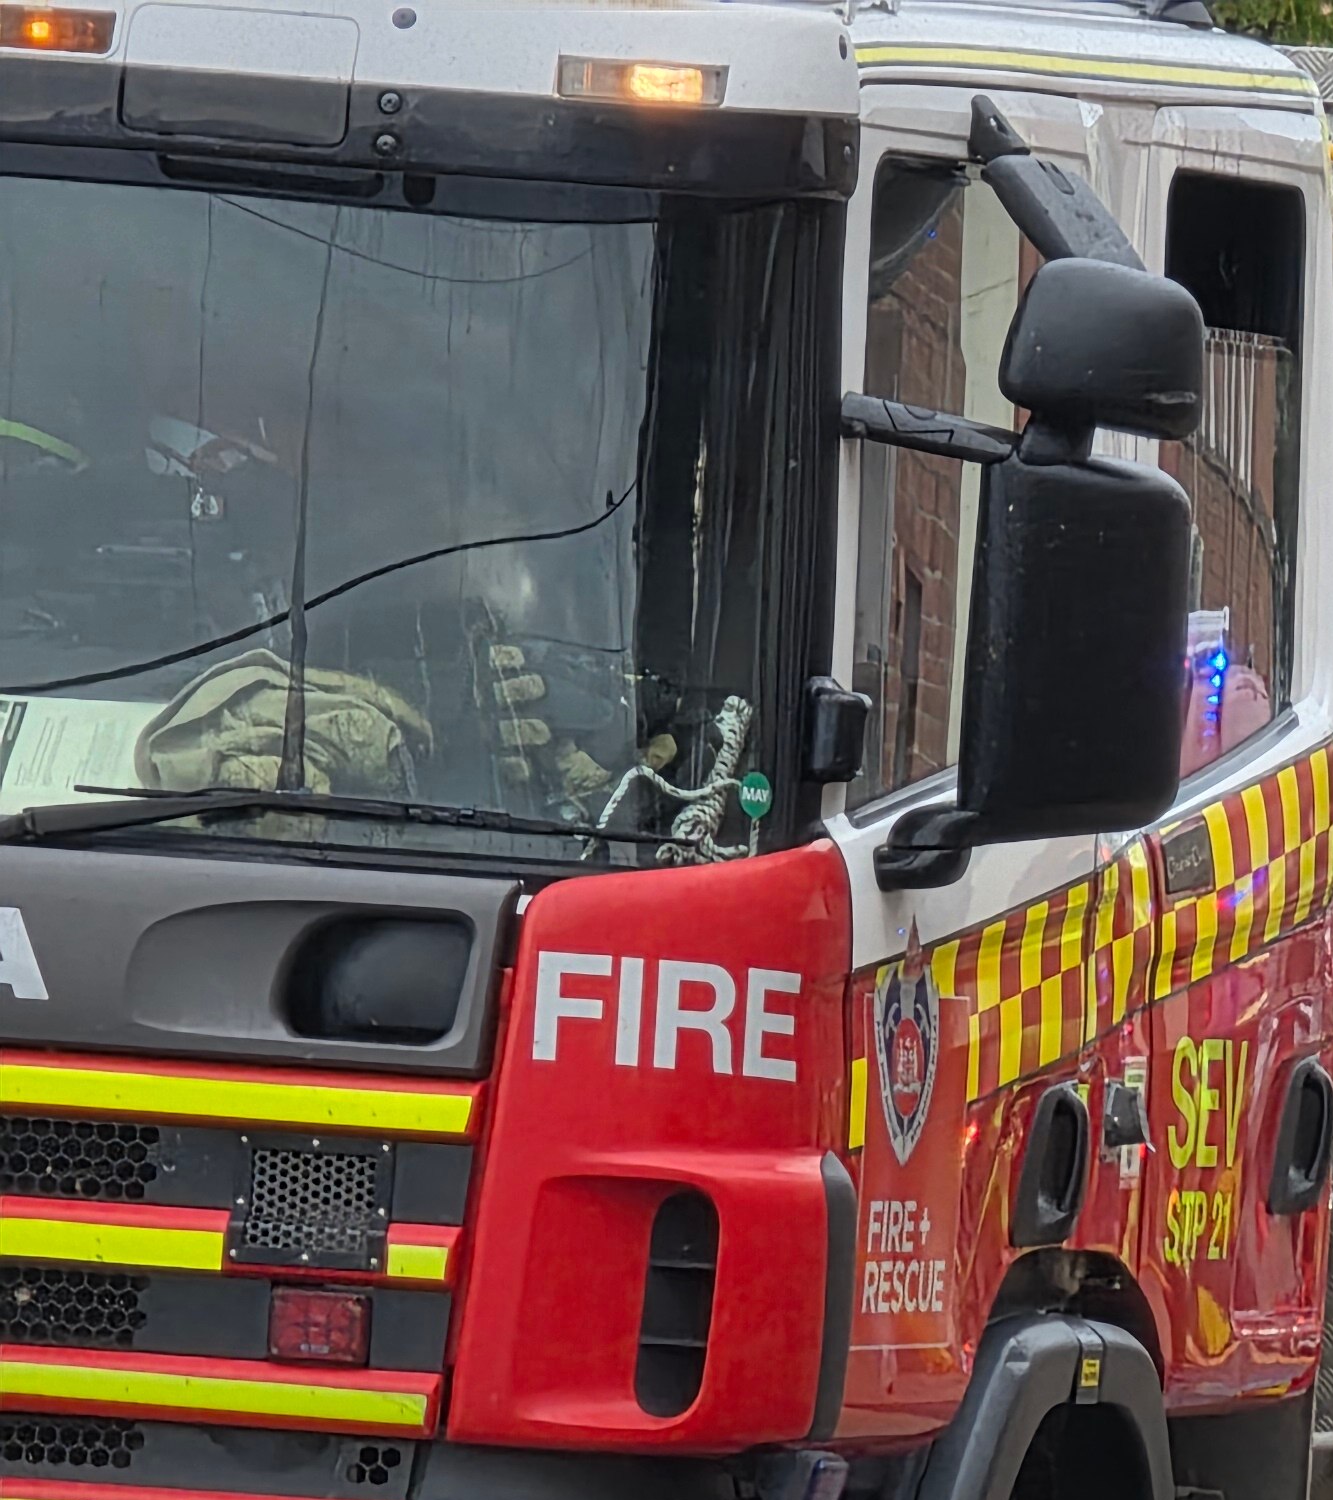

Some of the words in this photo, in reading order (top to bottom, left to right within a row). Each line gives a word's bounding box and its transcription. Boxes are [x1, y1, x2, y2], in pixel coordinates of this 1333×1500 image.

[742, 785, 769, 802] MAY
[532, 950, 802, 1083] FIRE
[1167, 1036, 1249, 1170] SEV
[867, 1200, 918, 1253] FIRE
[861, 1260, 946, 1315] RESCUE
